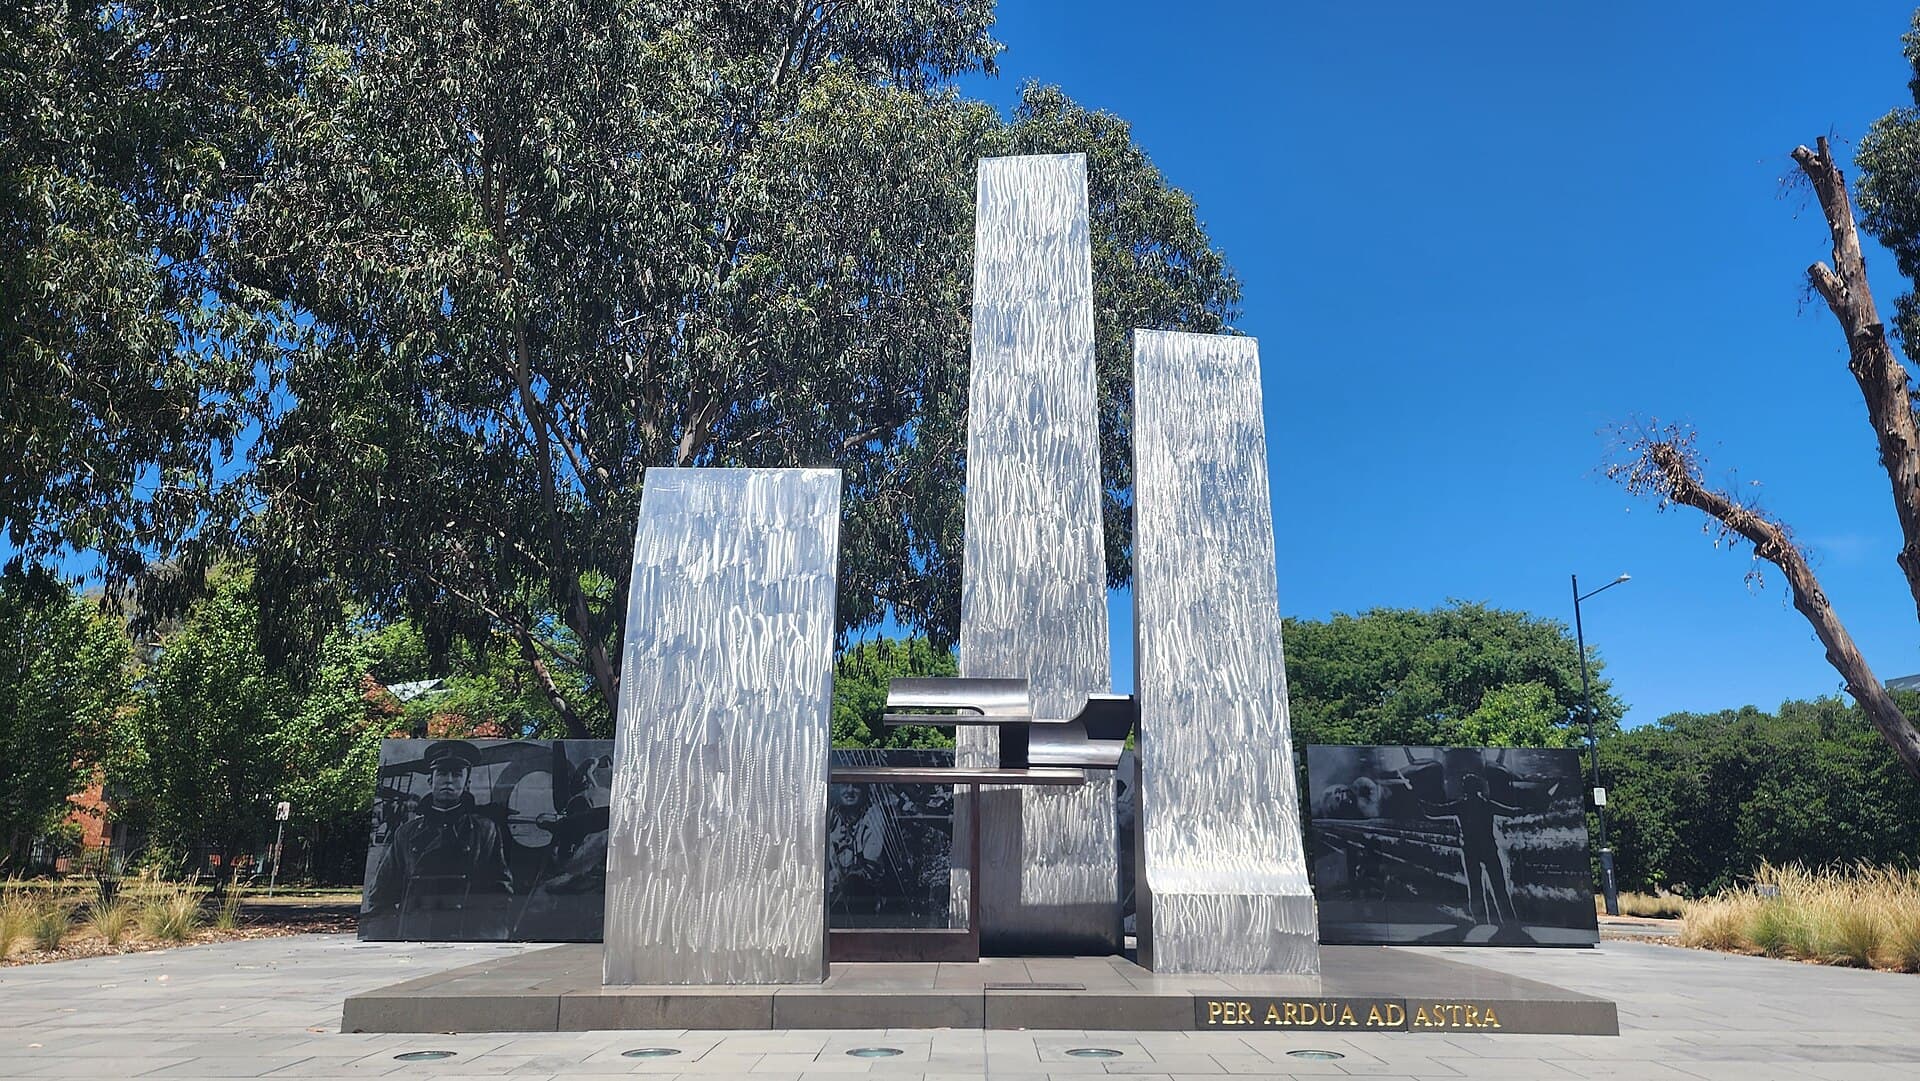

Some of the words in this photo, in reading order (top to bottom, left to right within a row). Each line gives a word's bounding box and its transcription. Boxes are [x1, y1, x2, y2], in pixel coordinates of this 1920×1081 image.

[1207, 1001, 1254, 1025] PER
[1264, 1002, 1358, 1026] ARDUA
[1366, 1003, 1406, 1027] AD
[1413, 1004, 1502, 1028] ASTRA
